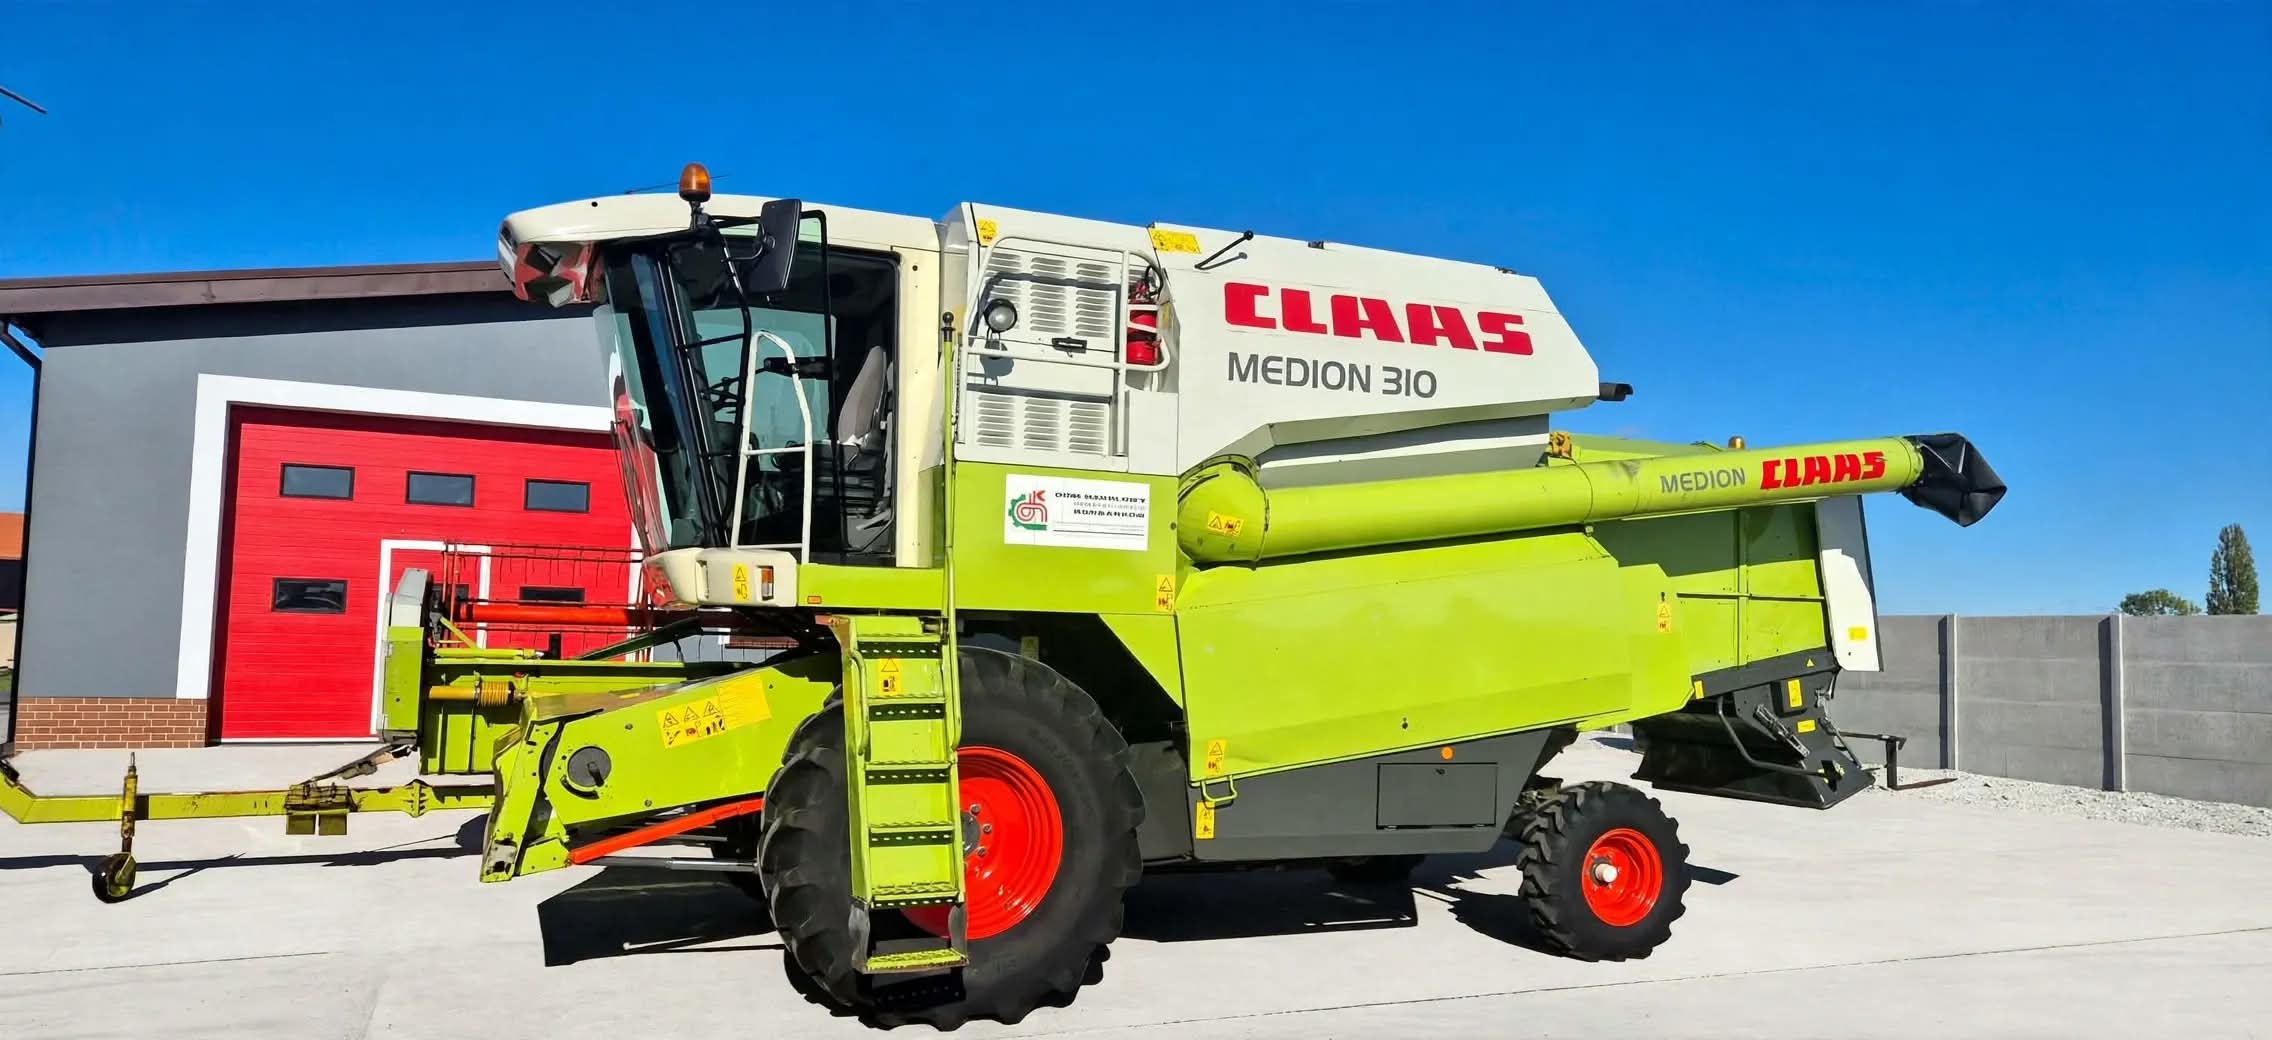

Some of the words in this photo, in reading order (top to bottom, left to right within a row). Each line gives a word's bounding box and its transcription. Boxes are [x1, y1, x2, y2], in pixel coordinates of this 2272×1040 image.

[1224, 282, 1533, 356] CLAAS
[1228, 351, 1371, 394] MEDION
[1382, 365, 1437, 399] 310
[1659, 468, 1746, 494] MEDION
[1760, 451, 1886, 490] CLAAS
